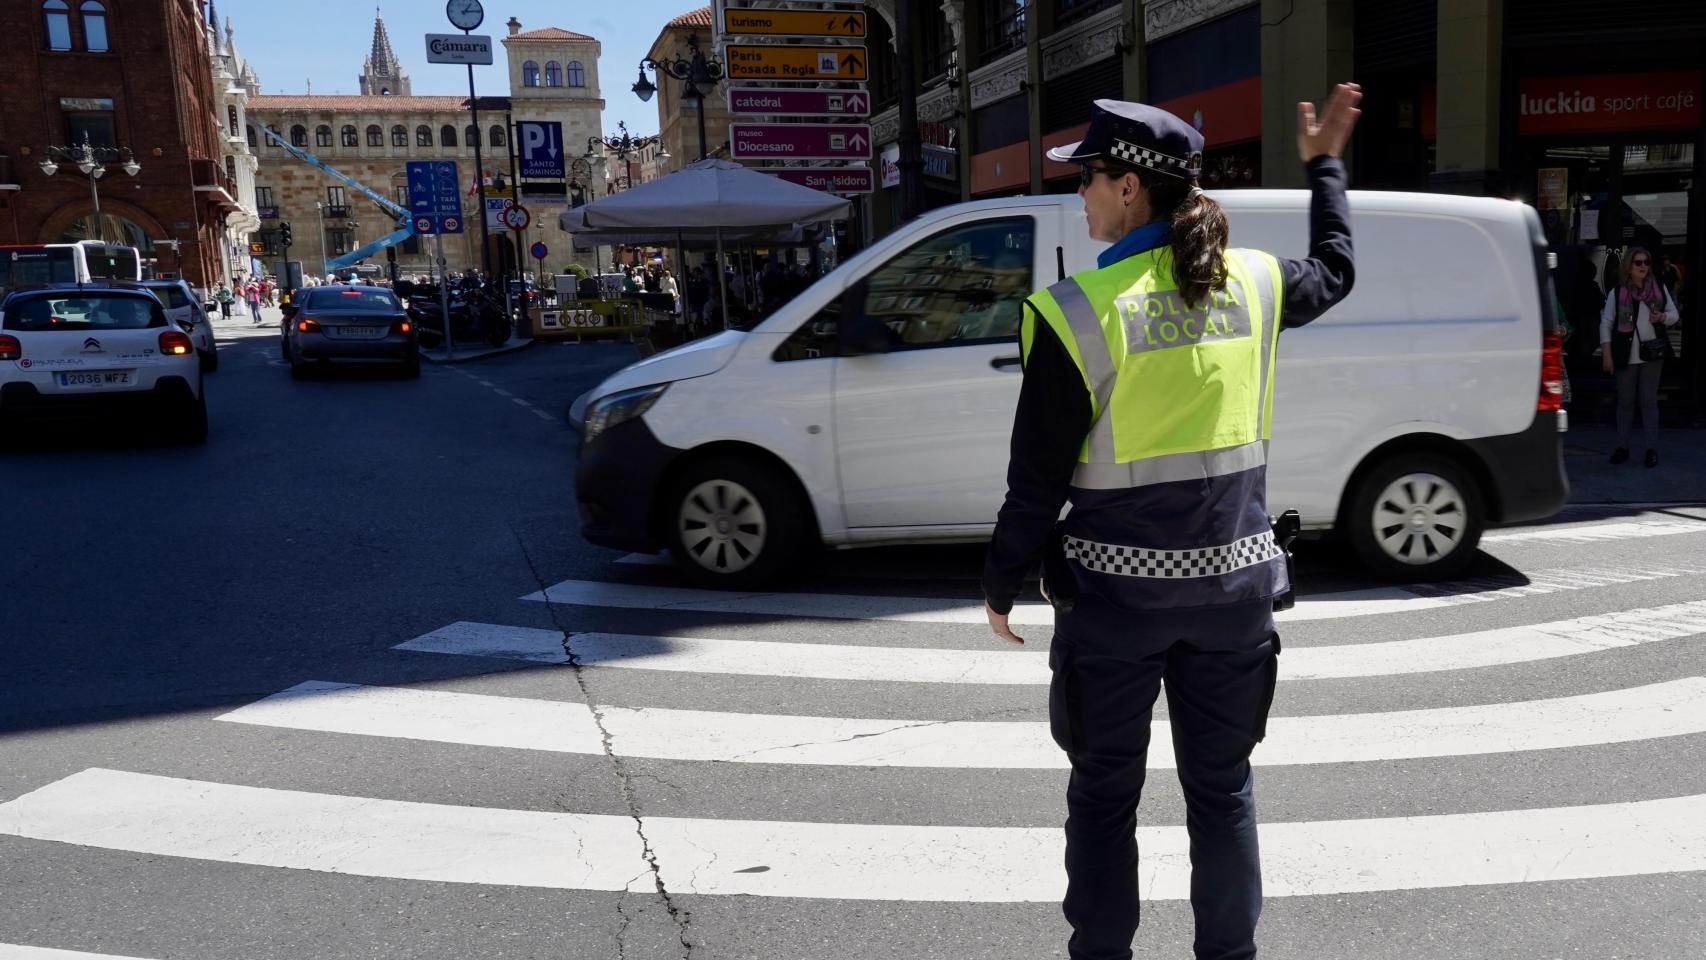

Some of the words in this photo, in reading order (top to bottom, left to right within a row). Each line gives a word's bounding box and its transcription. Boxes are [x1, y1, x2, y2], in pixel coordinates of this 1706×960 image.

[732, 17, 772, 28] turismo
[731, 51, 762, 61] Paris
[732, 63, 776, 74] Posada
[736, 96, 782, 108] catedral
[1520, 90, 1596, 116] luckia
[1603, 94, 1651, 115] sport
[1656, 89, 1696, 112] café
[522, 123, 545, 160] P
[738, 141, 794, 152] Diocesano
[529, 160, 555, 168] SANTO
[523, 168, 562, 176] DOMINGO
[806, 175, 826, 186] San
[833, 175, 867, 186] Isidoro
[1144, 313, 1234, 345] LOCAL
[70, 374, 101, 384] 2036
[105, 373, 128, 383] MFZ
